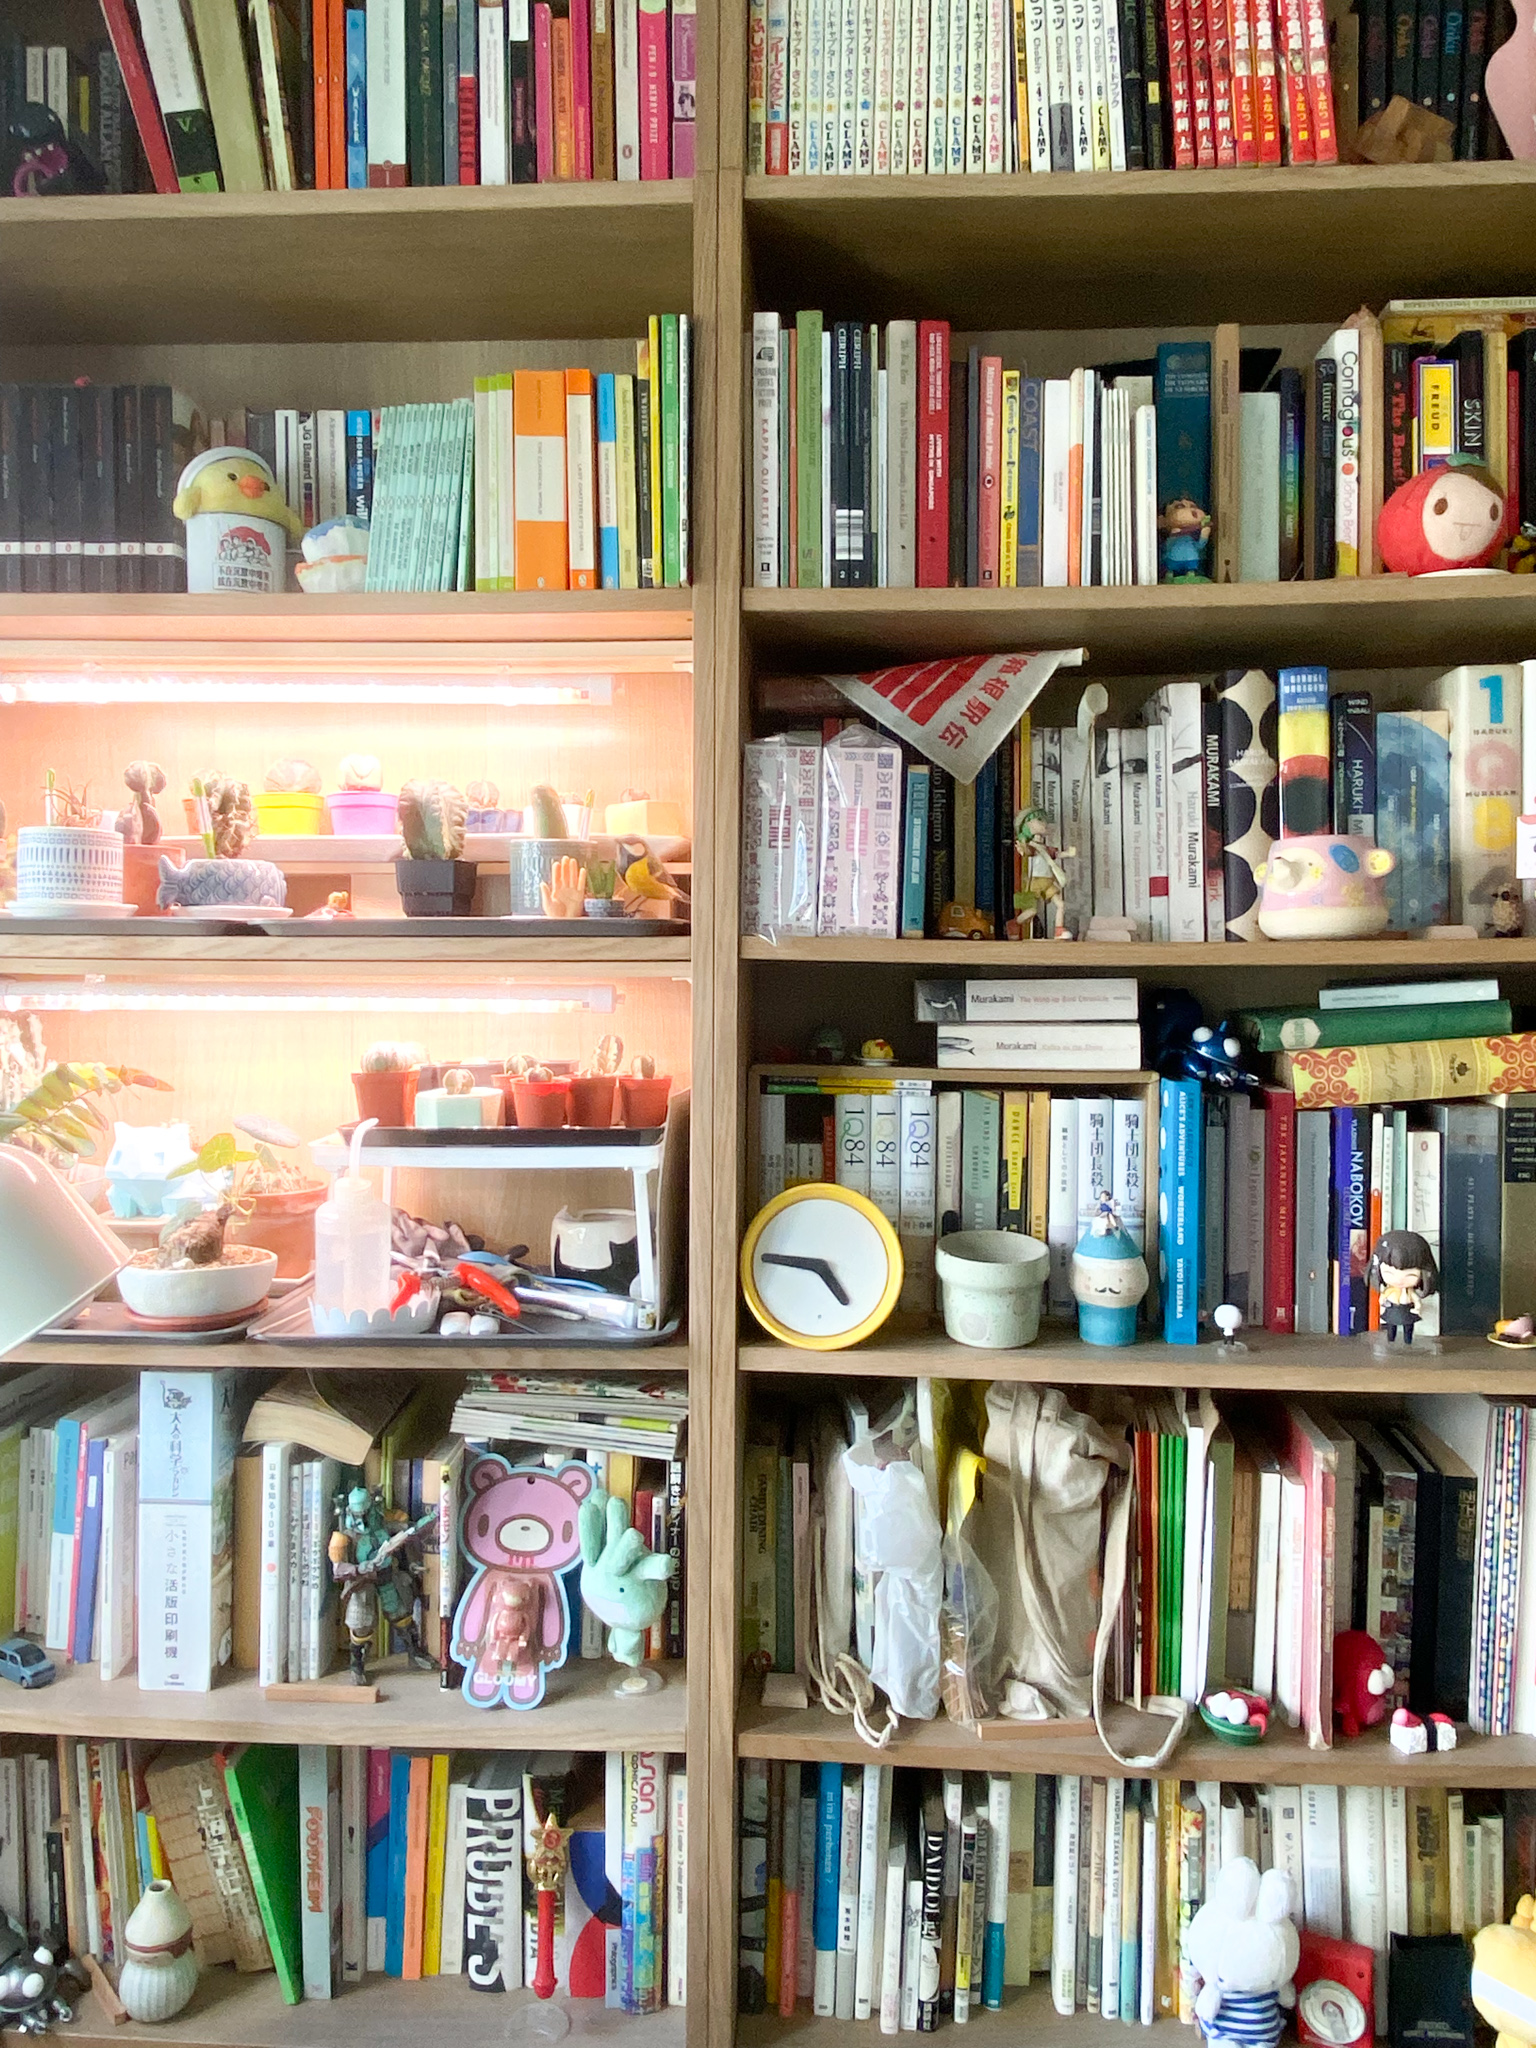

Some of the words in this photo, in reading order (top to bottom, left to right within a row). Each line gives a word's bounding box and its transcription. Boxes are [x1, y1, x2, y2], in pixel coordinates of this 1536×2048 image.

[648, 83, 657, 114] HENRY
[1242, 77, 1248, 91] 1
[1262, 78, 1272, 91] 2
[1294, 77, 1304, 90] 3
[1315, 76, 1326, 88] 5
[648, 117, 657, 144] PRIZE
[791, 121, 800, 170] CLAMP
[808, 120, 818, 170] CLAMP
[824, 121, 834, 171] CLAMP
[842, 119, 852, 169] CLAMP
[859, 118, 869, 168] CLAMP
[877, 120, 887, 169] CLAMP
[894, 119, 903, 169] CLAMP
[912, 118, 922, 168] CLAMP
[933, 116, 943, 167] CLAMP
[951, 116, 962, 166] CLAMP
[972, 114, 982, 164] CLAMP
[989, 113, 999, 163] CLAMP
[1037, 107, 1046, 157] CLAMP
[1058, 106, 1068, 156] CLAMP
[1079, 106, 1088, 156] CLAMP
[1098, 106, 1107, 157] CLAMP
[837, 328, 847, 369] CERIPH
[853, 329, 862, 370] CERIPH
[984, 366, 995, 405] Ministry
[1322, 382, 1332, 421] future
[1337, 351, 1358, 457] Contagious
[985, 406, 995, 416] of
[1022, 381, 1039, 451] COAST
[1392, 393, 1407, 427] The
[1432, 384, 1440, 432] FREUD
[1463, 398, 1481, 447] SKIN
[303, 425, 312, 441] JG
[761, 418, 769, 461] KAPPA
[1322, 425, 1332, 457] ideas
[302, 443, 312, 480] Ballard
[985, 445, 995, 469] Panic
[604, 496, 612, 524] READER
[761, 467, 769, 528] QUARTET
[1343, 478, 1354, 517] Jonah
[578, 531, 586, 552] LOVER
[1154, 750, 1162, 773] Haruki
[1205, 734, 1220, 807] MURAKAMI
[1048, 780, 1057, 824] Murakami
[1071, 779, 1080, 822] Murakami
[1102, 782, 1112, 825] Murakami
[1132, 782, 1142, 825] Murakami
[1154, 774, 1162, 808] Murakami
[1351, 759, 1364, 809] HARUKI
[930, 789, 947, 843] Ishiguro
[1187, 791, 1199, 828] Haruki
[1187, 831, 1200, 888] Murakami
[1208, 869, 1223, 903] Dark
[971, 994, 1014, 1004] Murakami
[996, 1041, 1037, 1050] Murakami
[1011, 1111, 1020, 1144] DANCE
[1177, 1091, 1186, 1122] ALICE'S
[1279, 1115, 1288, 1138] THE
[840, 1107, 865, 1167] 1Q84
[872, 1110, 897, 1168] 1Q84
[905, 1109, 931, 1169] 1Q84
[1124, 1113, 1139, 1202] 騎士団長殺し
[1177, 1123, 1186, 1177] ADVENTURES
[1279, 1144, 1288, 1201] JAPANESE
[1349, 1151, 1364, 1227] NABOKOV
[1176, 1185, 1185, 1246] WONDERLAND
[1279, 1205, 1288, 1238] MIND
[1176, 1284, 1184, 1319] KUSAMA
[757, 1473, 767, 1511] FAMILY
[749, 1495, 757, 1533] CHAIR
[757, 1512, 767, 1554] DINING
[164, 1528, 180, 1659] 小さな活版印刷機
[472, 1671, 537, 1687] GLOOMY
[677, 1803, 685, 1818] best
[1114, 1788, 1122, 1840] HANDMADE
[1366, 1807, 1377, 1840] JAPAN
[305, 1806, 324, 1913] FOODHEIM
[823, 1823, 835, 1874] perhonen
[1093, 1852, 1101, 1883] ZINE
[1112, 1841, 1120, 1867] ZAKKA
[675, 1885, 685, 1914] graphics
